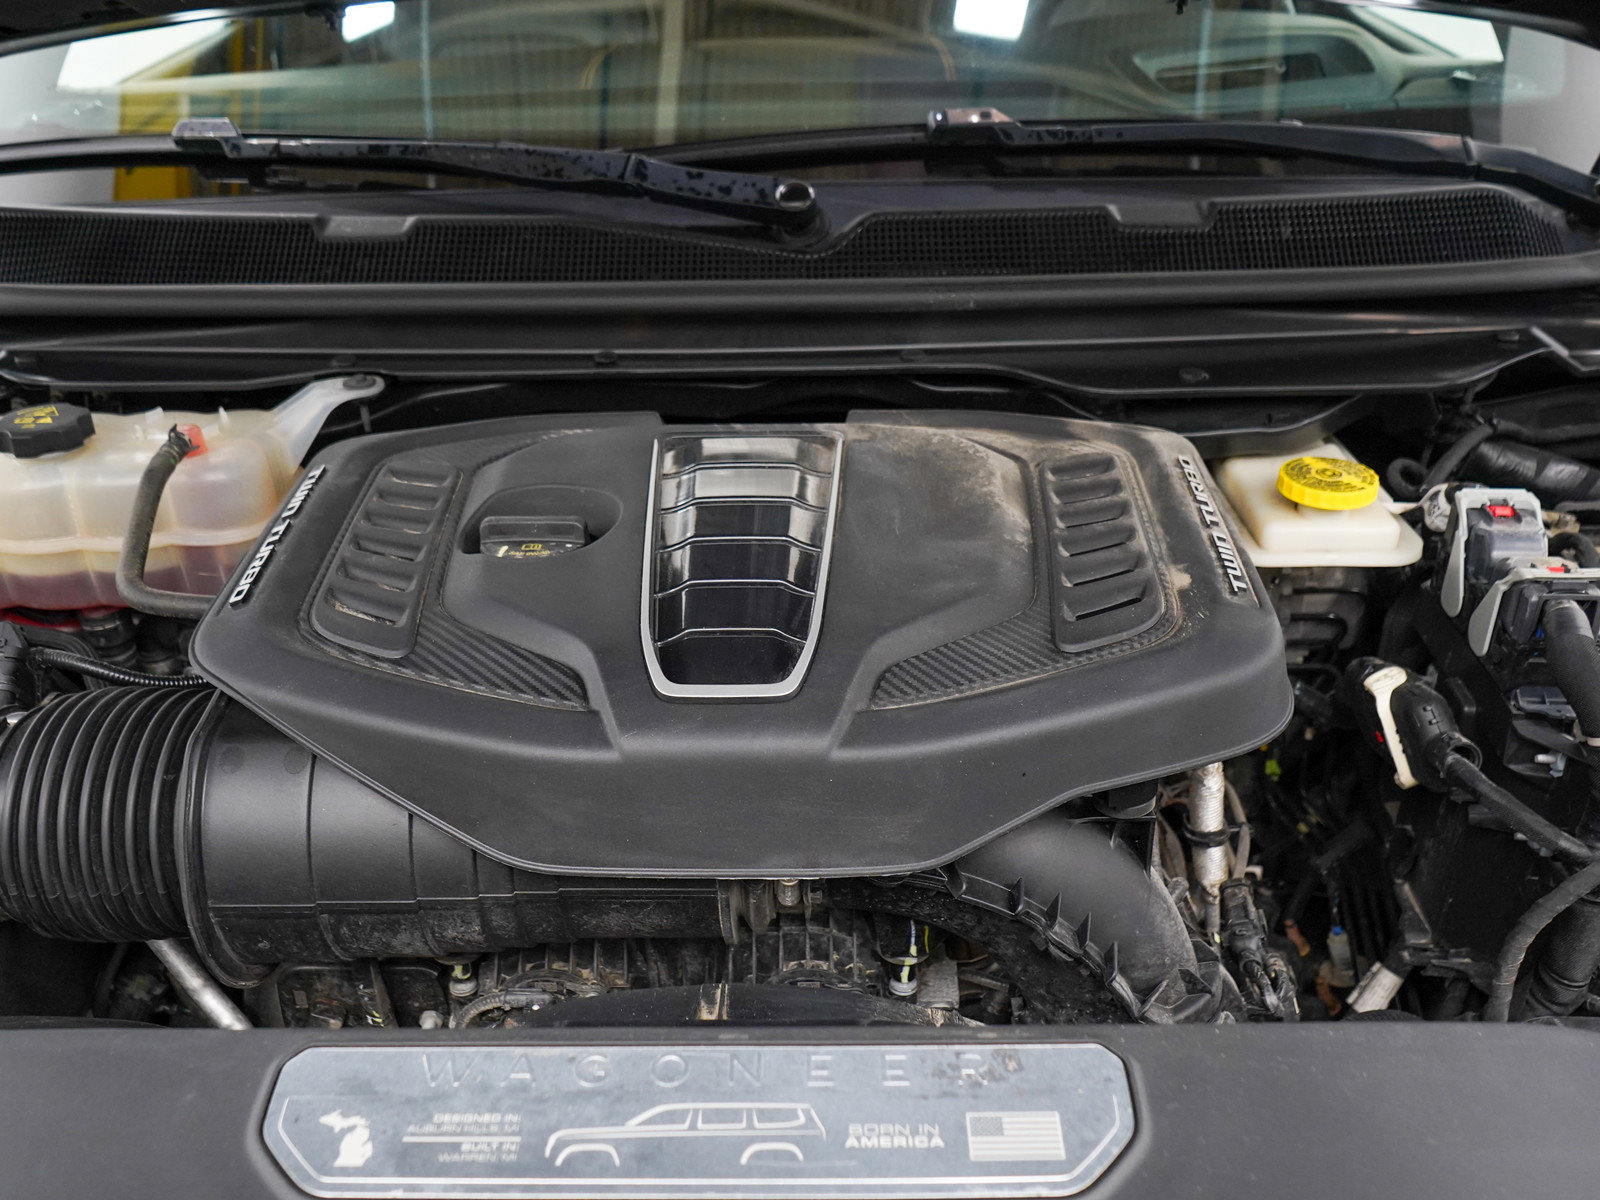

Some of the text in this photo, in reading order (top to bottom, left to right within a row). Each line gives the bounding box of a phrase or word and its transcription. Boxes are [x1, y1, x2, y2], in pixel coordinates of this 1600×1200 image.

[229, 464, 326, 604] TWIN TURBO
[1178, 455, 1248, 592] TWIN TURBO
[421, 1052, 992, 1088] WAGONEER
[844, 1135, 945, 1149] AMERICA
[848, 1123, 941, 1136] BORN IN
